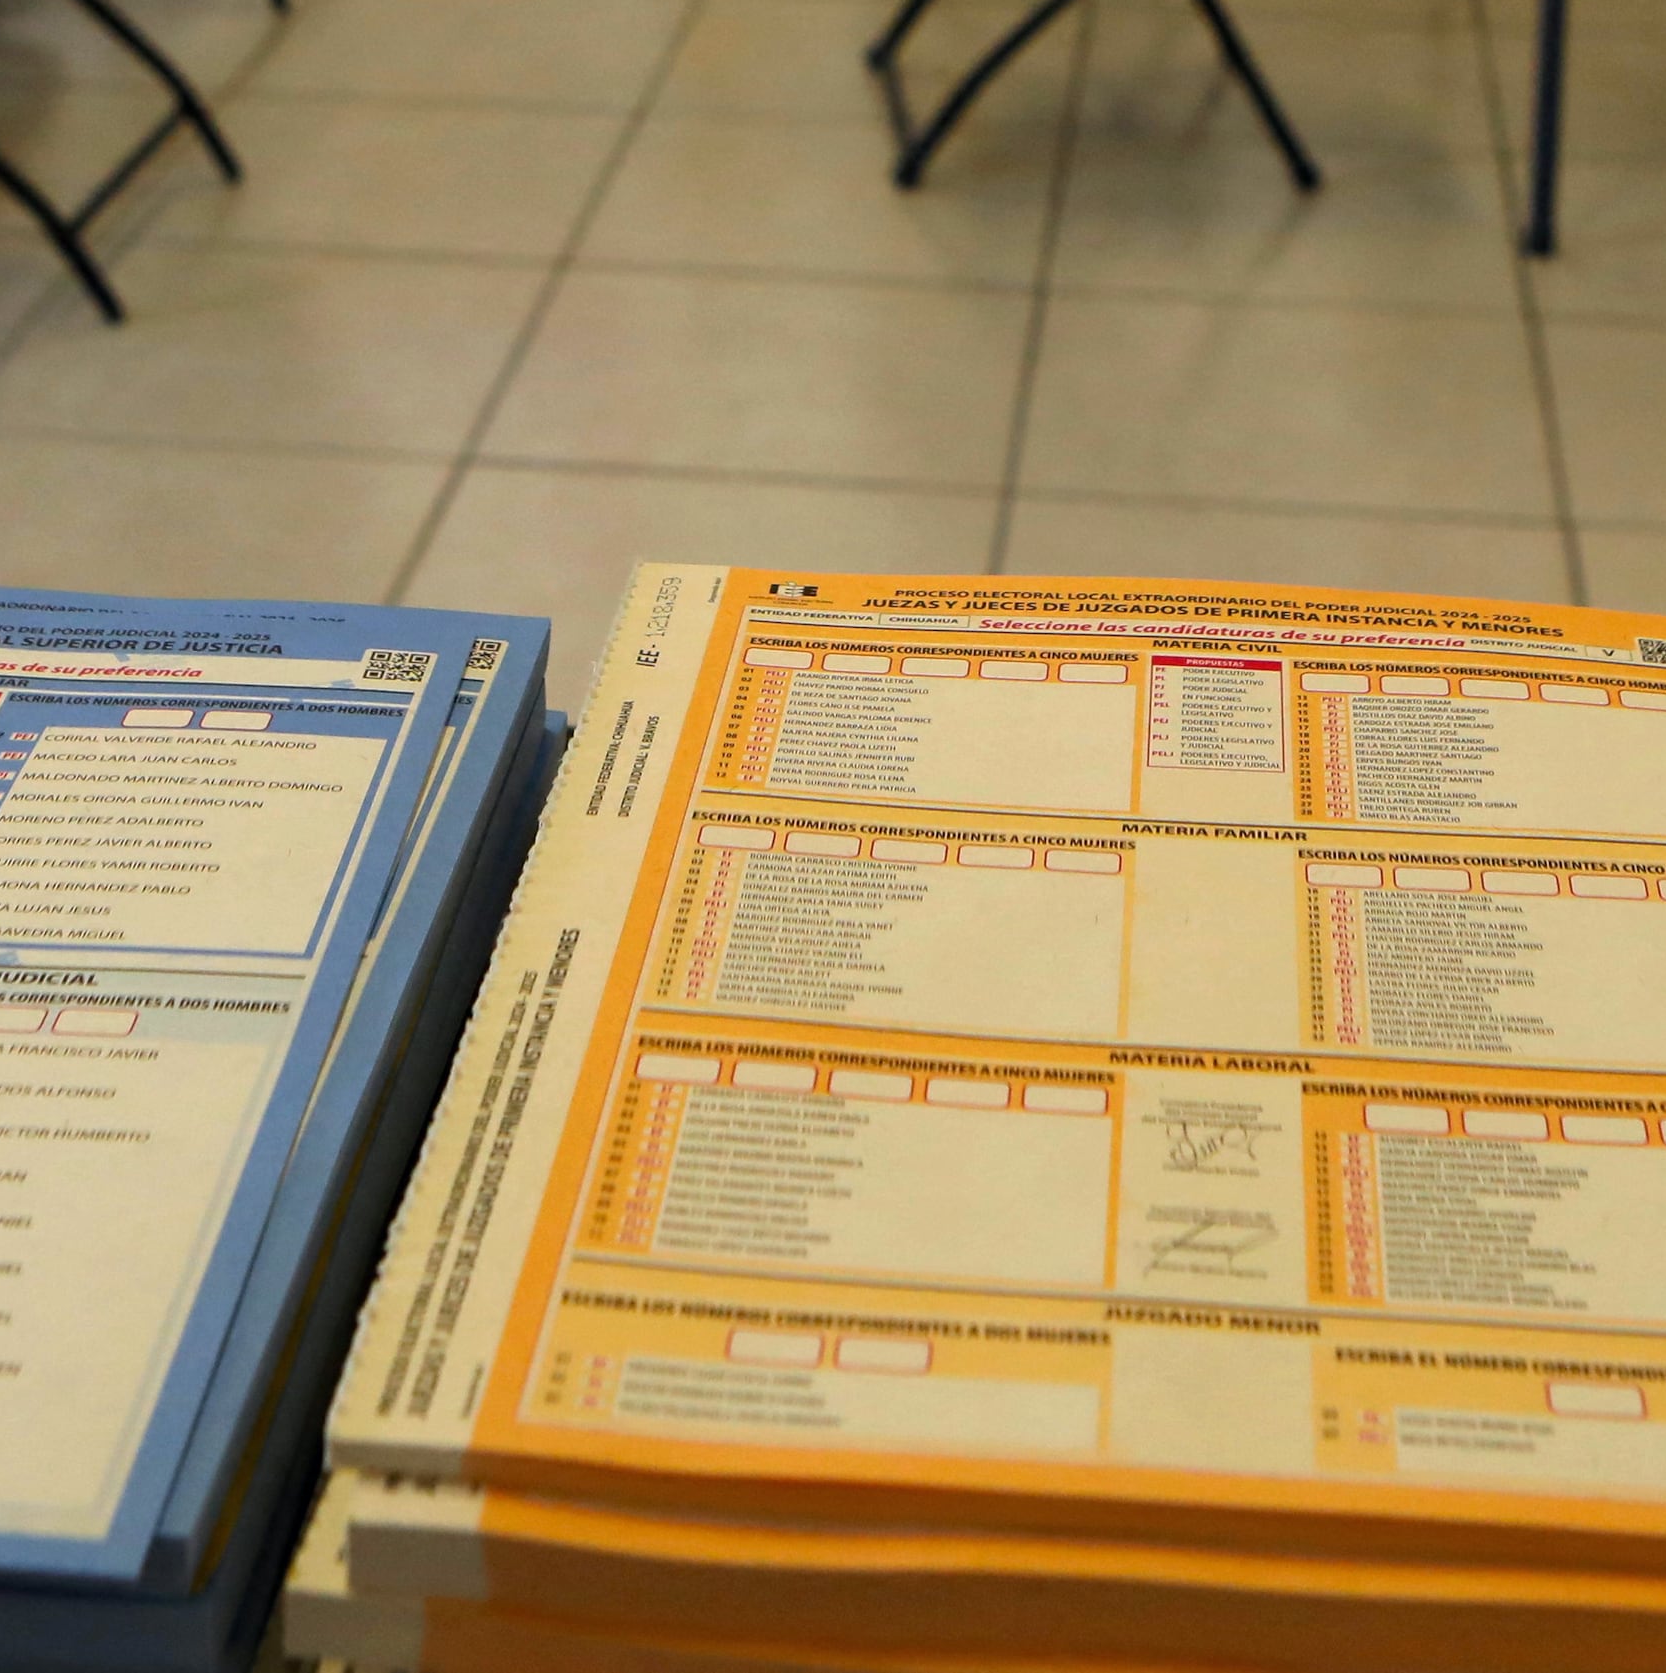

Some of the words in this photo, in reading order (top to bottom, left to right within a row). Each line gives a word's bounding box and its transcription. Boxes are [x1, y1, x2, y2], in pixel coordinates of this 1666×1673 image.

[749, 608, 801, 617] ENTIDAD
[803, 612, 874, 622] FEDERATIVA
[894, 590, 969, 598] PROCESO
[973, 590, 1062, 599] ELECTORAL
[1067, 592, 1119, 600] LOCAL
[1123, 593, 1266, 606] EXTRAORDINARIO
[1270, 599, 1300, 608] DEL
[1304, 601, 1359, 611] PODER
[1365, 605, 1436, 616] JUDICIAL
[1440, 610, 1479, 620] 2024
[1492, 614, 1532, 624] 2025
[861, 598, 939, 608] JUEZAS
[944, 600, 956, 608] Y
[964, 600, 1037, 610] JUECES
[1042, 602, 1069, 611] DE
[1075, 603, 1188, 616] JUZGADOS
[1193, 607, 1221, 617] DE
[1226, 608, 1320, 622] PRIMERA
[1326, 613, 1438, 628] INSTANCIA
[1442, 619, 1455, 630] Y
[1461, 621, 1563, 637] MENORES
[888, 616, 959, 625] CHIHUAHUA
[18, 623, 46, 633] DEL
[51, 625, 105, 636] PODER
[107, 628, 177, 639] JUDICIAL
[181, 631, 220, 640] 2024
[232, 632, 271, 640] 2025
[979, 619, 1091, 632] Seleccione
[1097, 621, 1127, 633] las
[1134, 623, 1275, 640] candidaturas
[1280, 629, 1306, 641] de
[1312, 634, 1336, 643] su
[1340, 632, 1466, 648] preferencia
[21, 634, 137, 651] SUPERIOR
[143, 640, 174, 652] DE
[179, 641, 284, 654] JUSTICIA
[750, 637, 802, 649] ESCRIBA
[805, 640, 827, 650] LOS
[830, 642, 894, 653] NÚMEROS
[896, 645, 1025, 659] CORRESPONDIENTES
[1028, 650, 1036, 659] A
[1039, 650, 1077, 660] CINCO
[1080, 652, 1139, 662] MUJERES
[1153, 640, 1231, 650] MATERIA
[1236, 643, 1282, 652] CIVIL
[1471, 638, 1522, 648] DISTRITO
[1527, 642, 1577, 653] JUDICIAL
[635, 650, 660, 667] IEE
[1603, 648, 1615, 658] V
[22, 662, 47, 674] de
[53, 667, 75, 675] su
[79, 665, 202, 679] preferencia
[1187, 658, 1245, 667] PROPUESTAS
[1212, 677, 1263, 686] LEGISLATIVO
[1294, 660, 1345, 671] ESCRIBA
[1350, 662, 1372, 672] LOS
[1375, 663, 1439, 675] NÚMEROS
[1443, 665, 1573, 683] CORRESPONDIENTES
[1576, 674, 1584, 684] A
[1587, 675, 1625, 687] CINCO
[1212, 686, 1247, 694] JUDICIAL
[8, 693, 64, 704] ESCRIBA
[66, 694, 90, 705] LOS
[92, 695, 158, 707] NÚMEROS
[160, 697, 293, 712] CORRESPONDIENTES
[295, 702, 305, 712] A
[307, 702, 335, 714] DOS
[337, 704, 405, 717] HOMBRES
[43, 733, 98, 743] CORRAL
[102, 735, 172, 744] VALVERDE
[176, 736, 227, 745] RAFAEL
[231, 737, 318, 750] ALEJANDRO
[32, 752, 97, 762] MACEDO
[99, 753, 137, 762] LARA
[141, 754, 178, 764] JUAN
[180, 756, 238, 766] CARLOS
[1121, 823, 1208, 836] MATERIA
[1214, 828, 1307, 841] FAMILIAR
[1110, 1051, 1205, 1068] MATERIA
[1213, 1057, 1314, 1073] LABORAL
